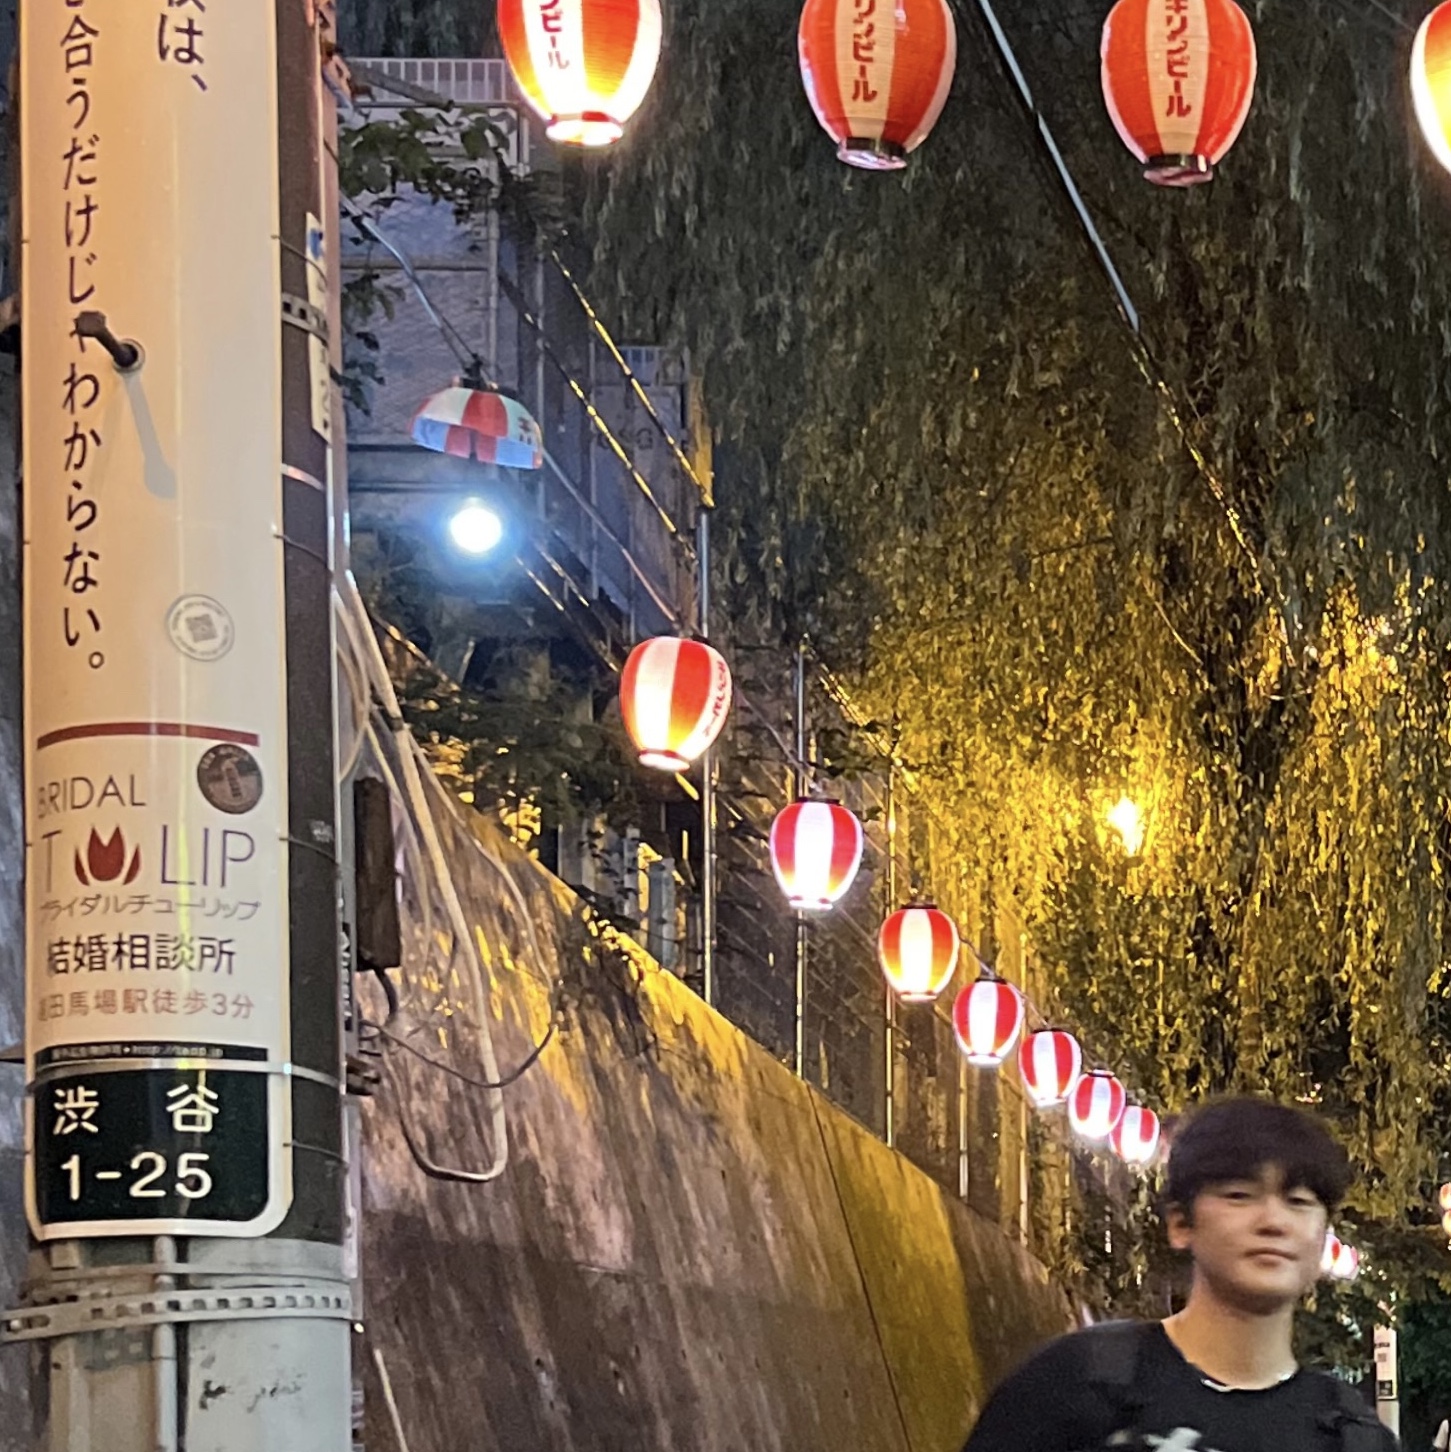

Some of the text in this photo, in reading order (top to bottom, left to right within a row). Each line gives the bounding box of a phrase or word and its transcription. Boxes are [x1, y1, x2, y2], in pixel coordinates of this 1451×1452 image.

[158, 0, 207, 91] は、
[60, 0, 104, 670] 合うだけじわからない。
[38, 774, 147, 819] BRIDAL
[40, 893, 261, 924] ライダルチューリップ
[47, 931, 236, 975] 結婚相談所
[38, 988, 255, 1021] 田馬場駅徒歩3分
[53, 1084, 220, 1136] 渋谷
[61, 1152, 213, 1201] 1-25
